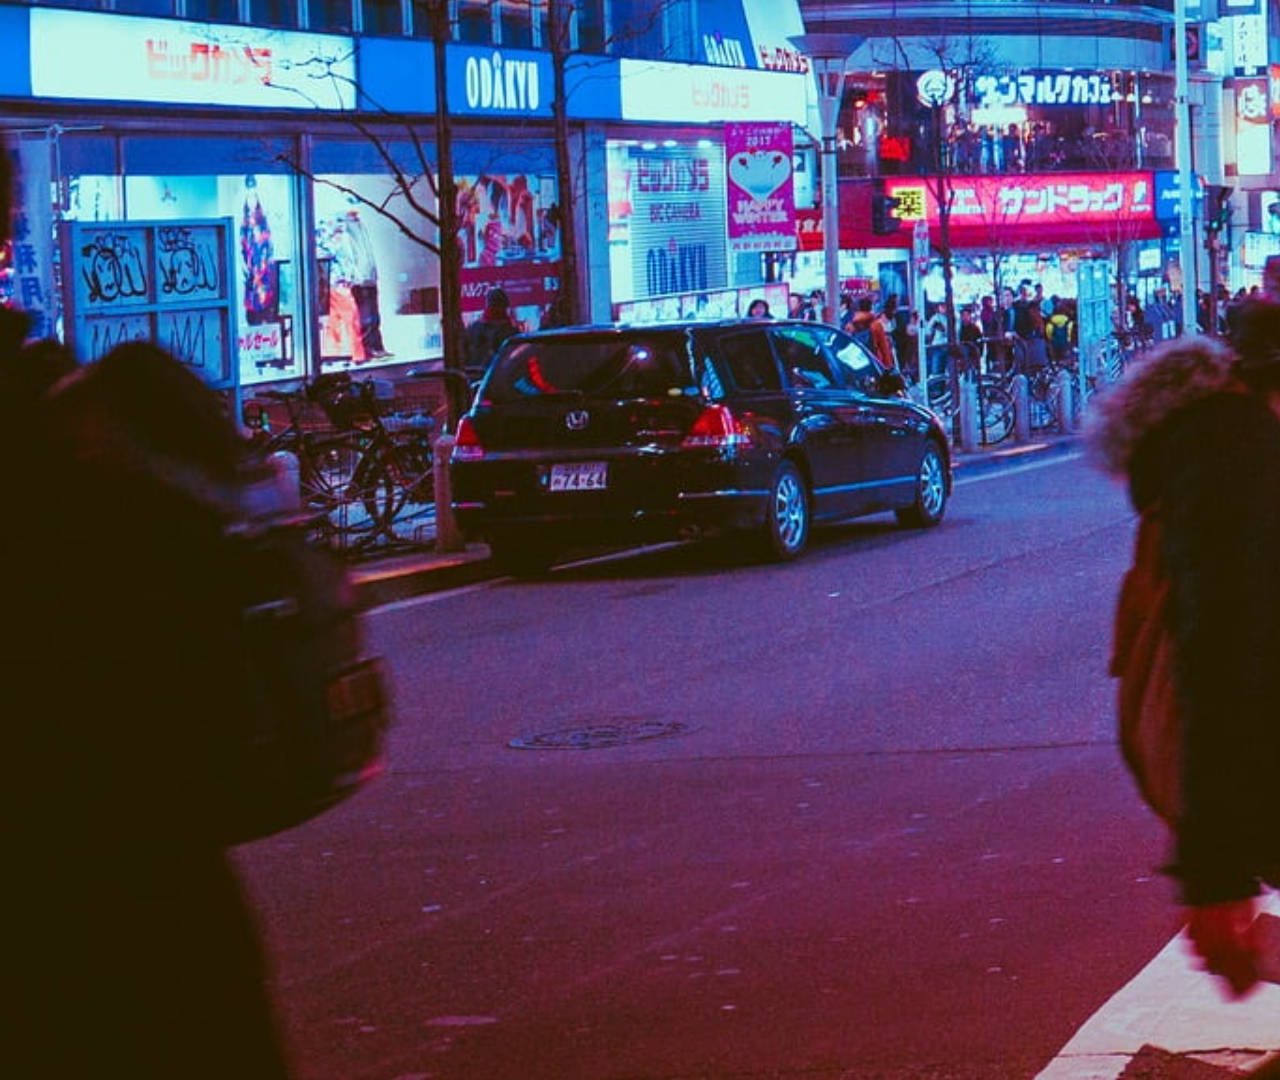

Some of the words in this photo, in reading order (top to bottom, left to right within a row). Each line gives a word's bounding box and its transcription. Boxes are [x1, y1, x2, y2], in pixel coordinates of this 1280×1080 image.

[466, 51, 539, 111] ODAKYU
[999, 183, 1123, 215] サンドラッグ
